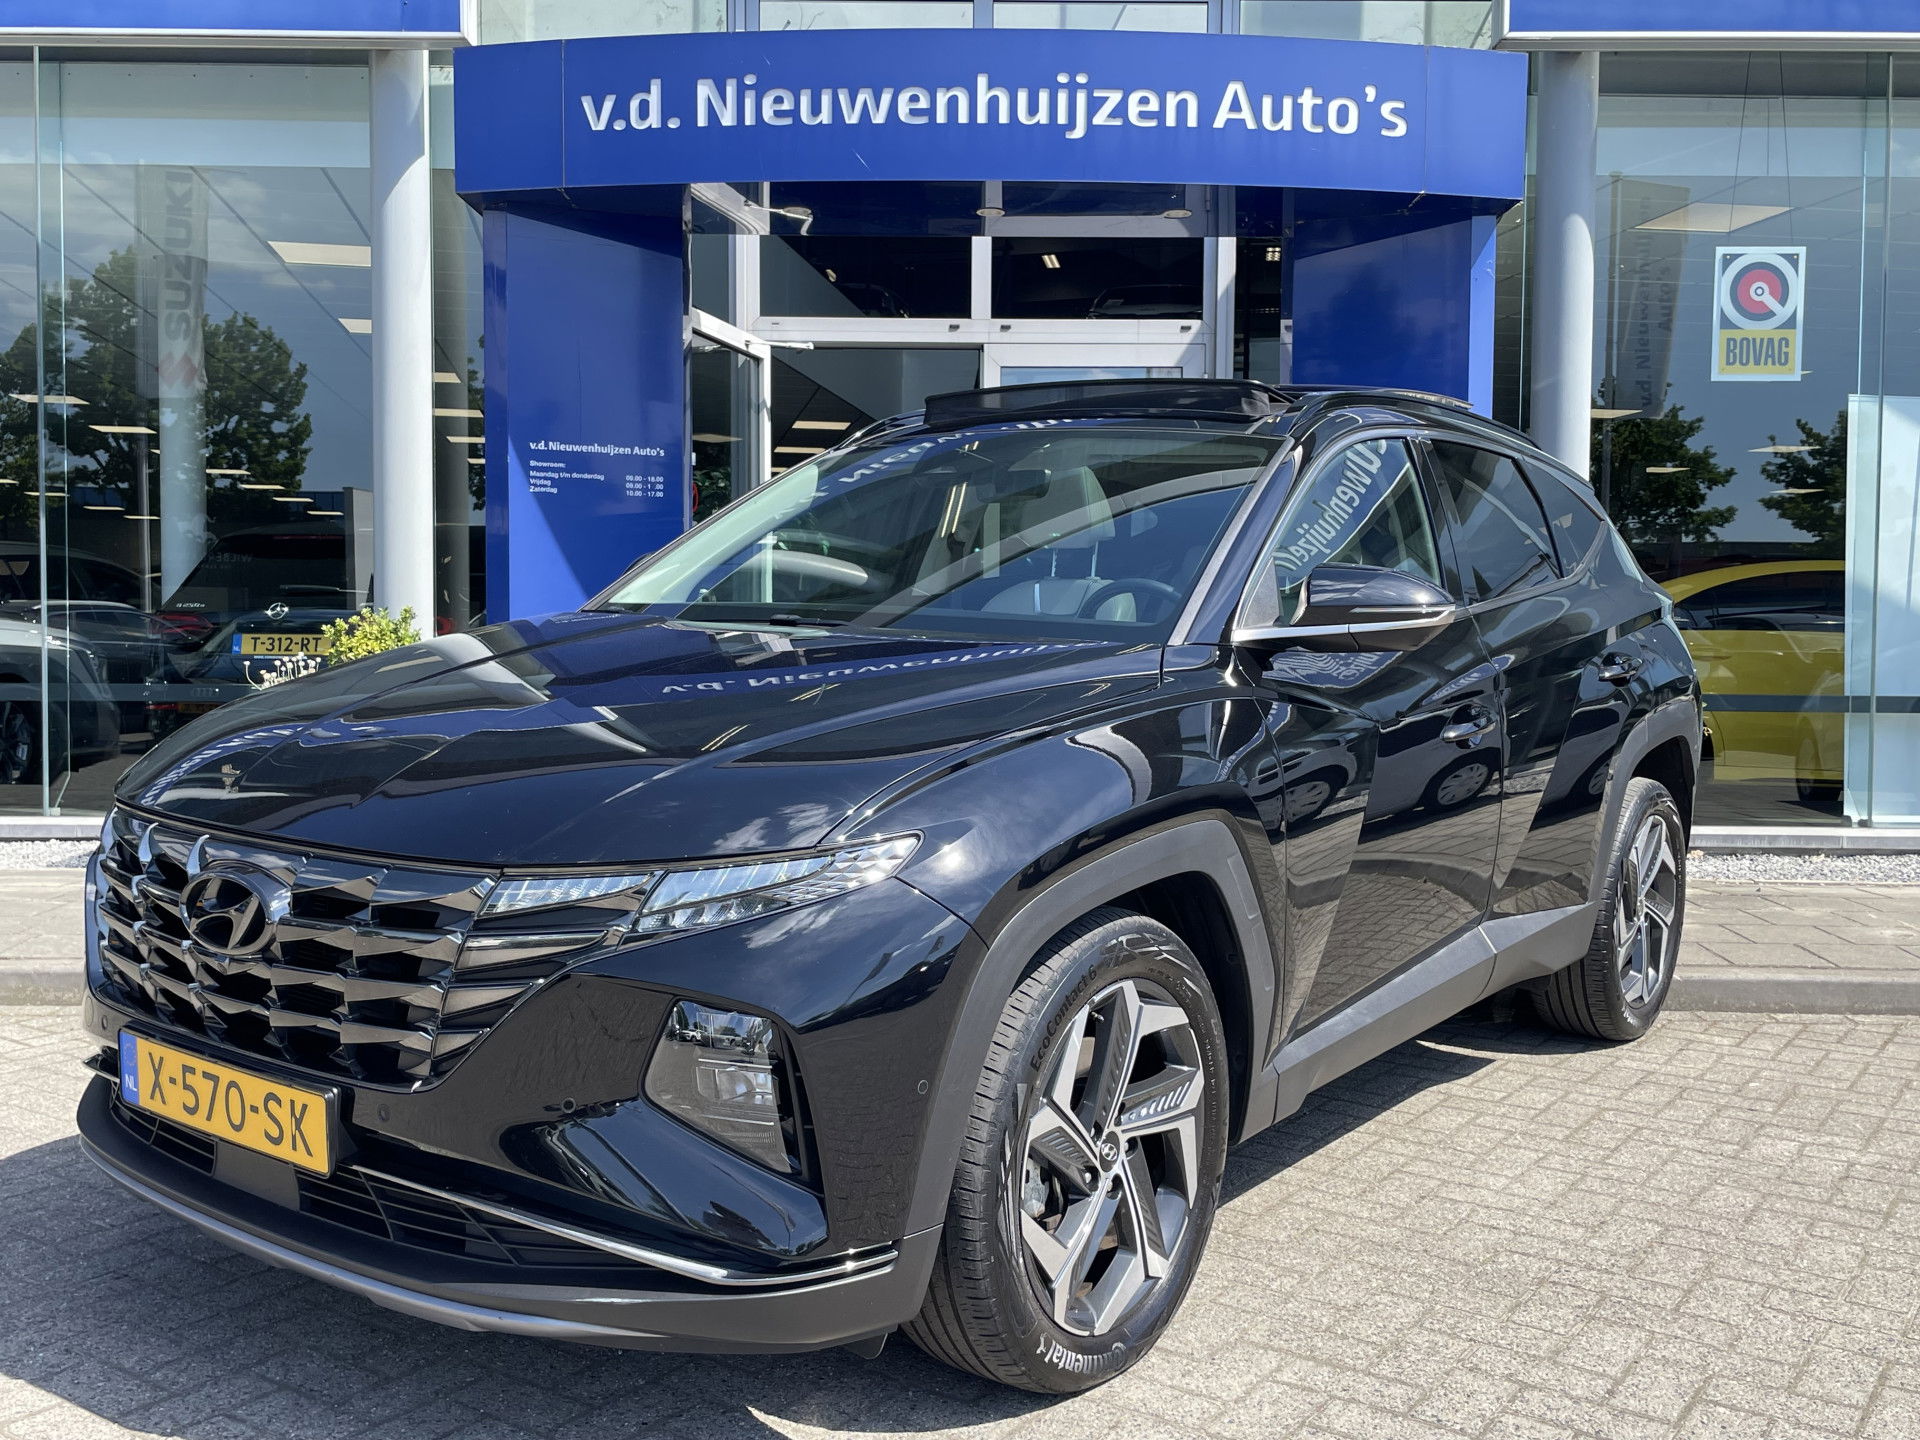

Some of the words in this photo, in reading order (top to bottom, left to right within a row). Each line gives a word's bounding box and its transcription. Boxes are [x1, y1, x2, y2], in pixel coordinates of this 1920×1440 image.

[580, 78, 681, 131] v.d.
[696, 72, 1198, 139] Nieuwenhuijzen
[1212, 80, 1409, 138] Auto's
[164, 171, 193, 341] SUZUKI
[1725, 337, 1790, 367] BOVAG
[529, 440, 548, 450] v.d.
[548, 441, 631, 456] Nieuwenhuijzen
[633, 446, 665, 456] Auto's
[529, 460, 566, 468] Showroom:
[529, 470, 559, 479] Maandag
[571, 472, 605, 481] donderdag
[529, 478, 552, 487] Vrijdag
[529, 485, 558, 494] Zaterdag
[250, 636, 322, 653] T-312-RT
[1029, 974, 1089, 1073] EcoContact
[1089, 964, 1099, 982] 6
[124, 1072, 138, 1092] NL
[148, 1051, 314, 1158] X-570-SK
